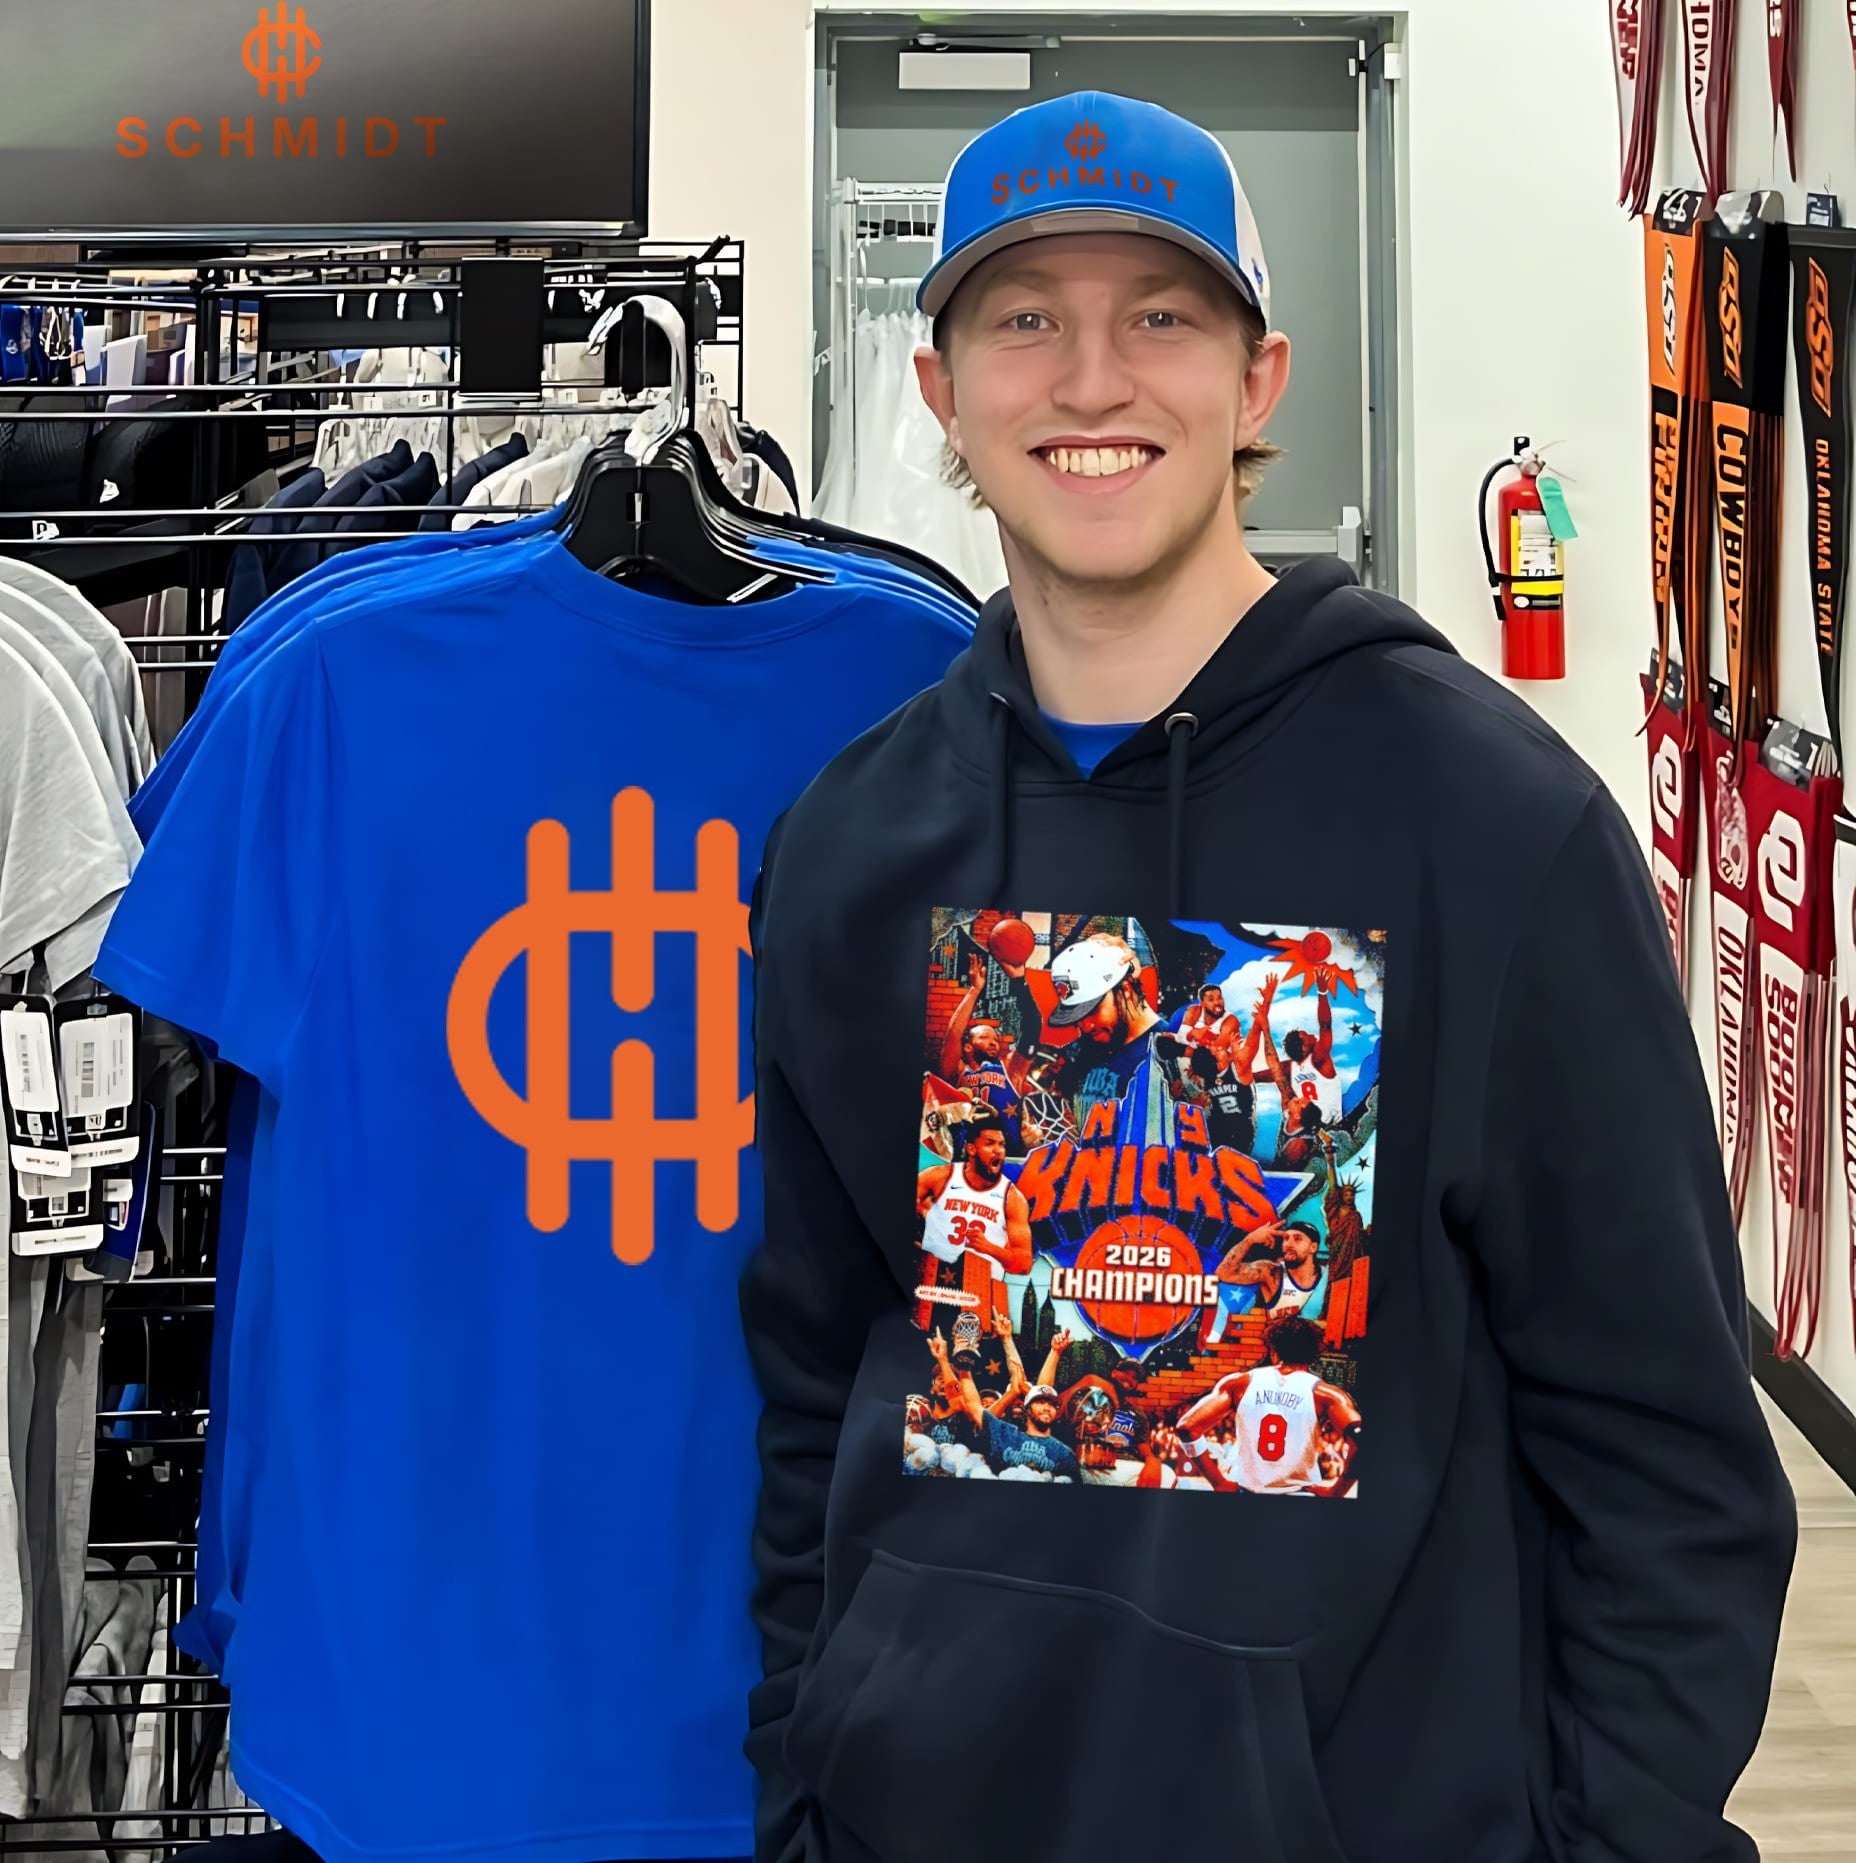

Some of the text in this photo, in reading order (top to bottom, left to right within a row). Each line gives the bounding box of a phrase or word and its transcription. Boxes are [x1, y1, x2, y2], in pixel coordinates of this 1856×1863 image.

[115, 117, 448, 158] SCHMIDT
[992, 166, 1179, 204] SCHMIDT
[1815, 439, 1832, 570] OKLAHOMA
[1718, 926, 1745, 1143] OKLAHOMA
[1015, 1137, 1280, 1232] KNICKS
[944, 1199, 999, 1223] NEW YORK
[1105, 1244, 1172, 1267] 2026
[1052, 1267, 1219, 1305] CHAMPIONS
[1257, 1413, 1288, 1461] 8
